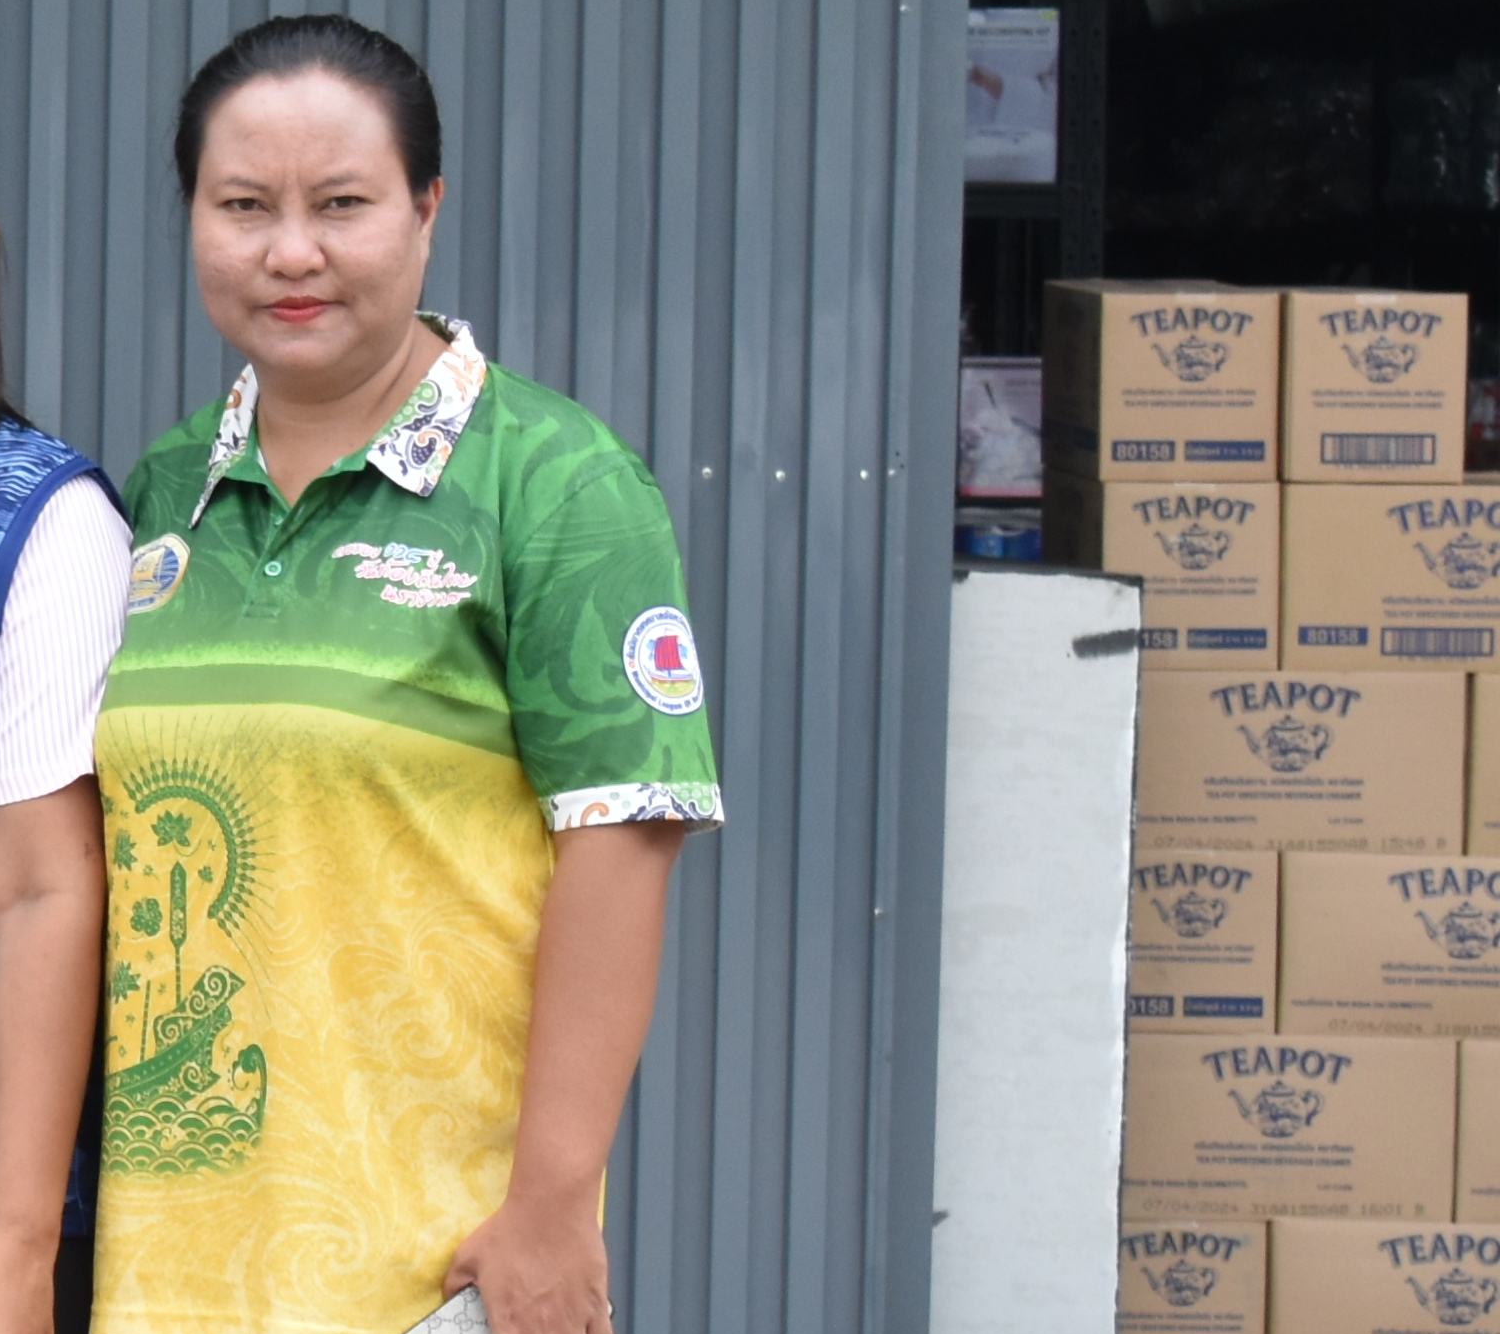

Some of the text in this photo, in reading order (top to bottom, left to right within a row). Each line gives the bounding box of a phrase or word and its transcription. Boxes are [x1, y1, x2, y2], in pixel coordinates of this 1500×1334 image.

[1131, 307, 1253, 337] TEAPOT
[1320, 308, 1442, 338] TEAPOT
[1115, 441, 1171, 460] 80158
[1132, 495, 1256, 526] TEAPOT
[1386, 498, 1500, 535] TEAPO
[1140, 629, 1174, 649] 158
[1306, 628, 1360, 645] 80158
[1210, 681, 1361, 717] TEAPOT
[1131, 862, 1252, 893] TEAPOT
[1388, 867, 1500, 902] TEAPO
[1129, 998, 1168, 1015] 0158
[1202, 1046, 1353, 1084] TEAPOT
[1121, 1231, 1242, 1262] TEAPOT
[1379, 1234, 1500, 1268] TEAPO
